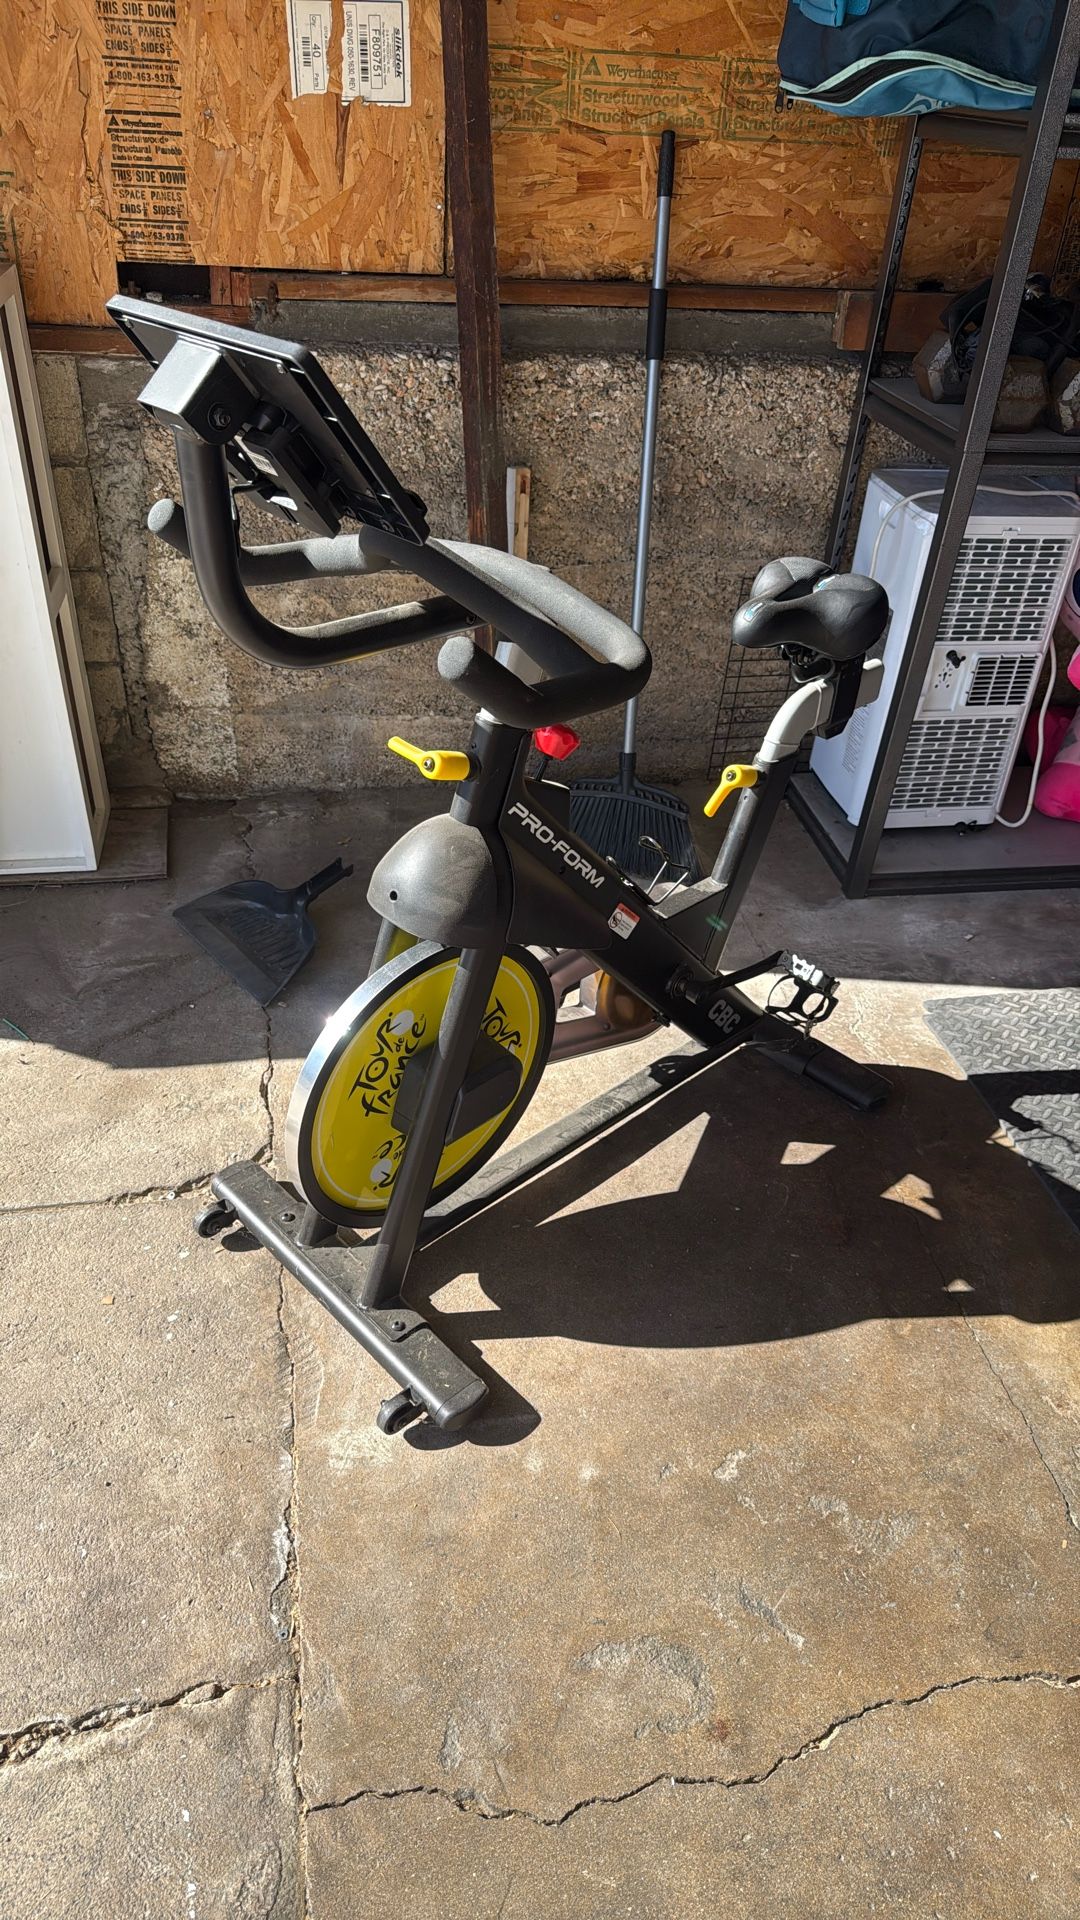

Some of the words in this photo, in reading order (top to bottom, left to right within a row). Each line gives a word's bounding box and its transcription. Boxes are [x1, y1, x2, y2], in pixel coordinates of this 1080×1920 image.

[95, 0, 118, 14] THIS
[122, 2, 144, 17] SIDE
[148, 4, 176, 19] DOWN
[104, 24, 132, 36] SPACE
[138, 26, 171, 38] PANELS
[106, 39, 128, 51] ENDS
[141, 42, 165, 54] SIDES
[312, 44, 321, 58] 40
[372, 28, 381, 77] F809751
[112, 169, 133, 182] THIS
[136, 170, 156, 183] SIDE
[160, 172, 186, 184] DOWN
[119, 189, 146, 200] SPACE
[150, 191, 182, 202] PANELS
[120, 203, 142, 213] ENDS
[153, 205, 176, 216] SIDES
[508, 802, 605, 888] PRO-FORM
[708, 1000, 741, 1034] CBC
